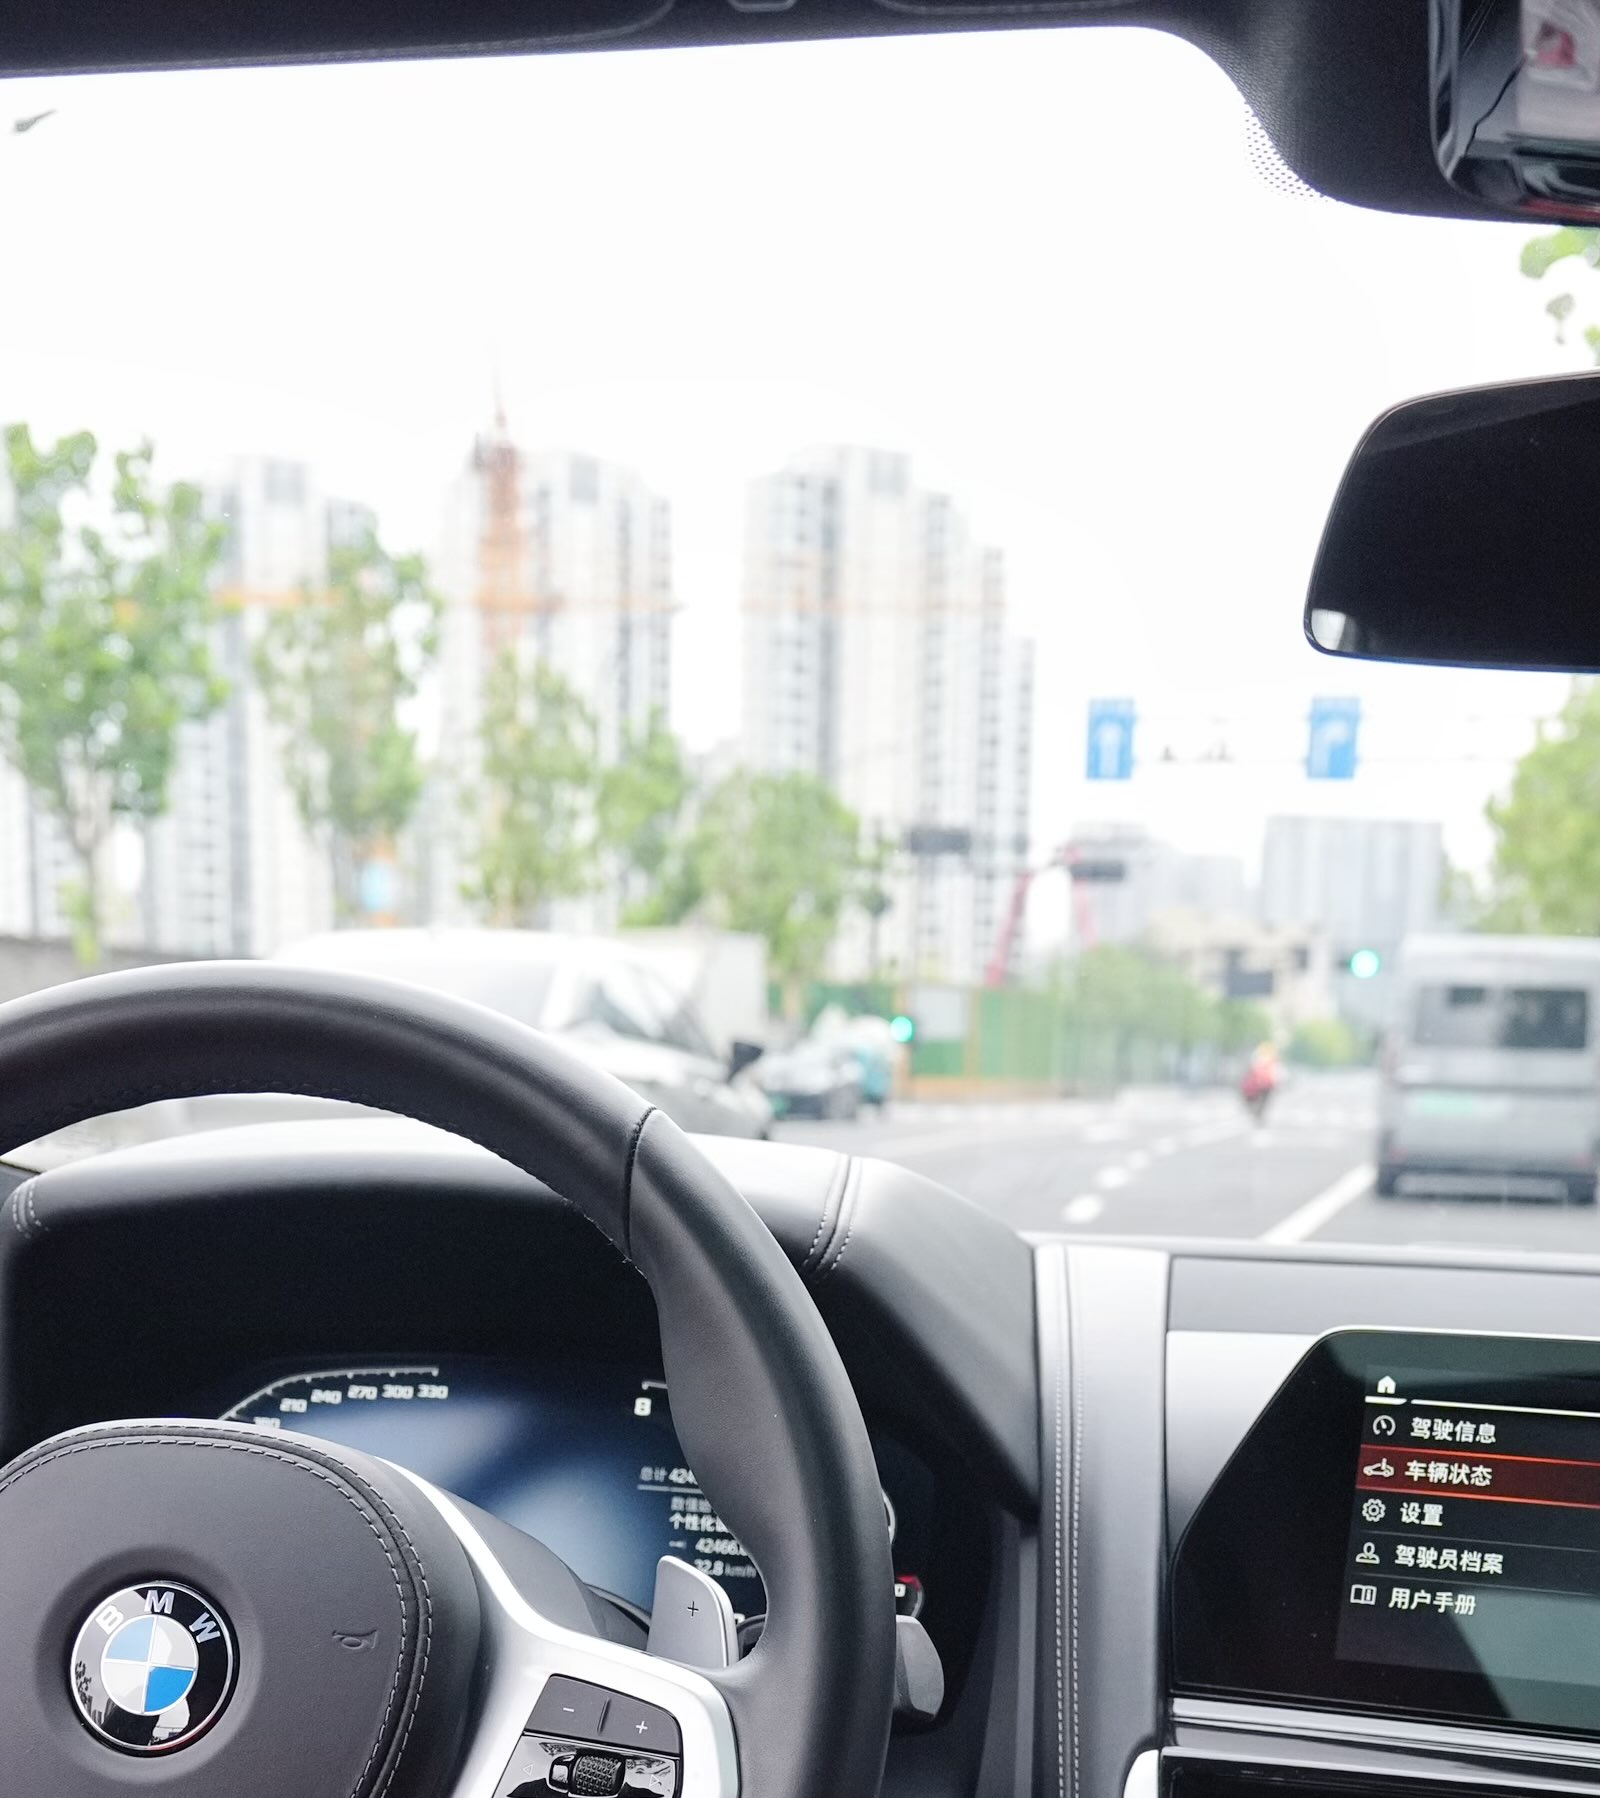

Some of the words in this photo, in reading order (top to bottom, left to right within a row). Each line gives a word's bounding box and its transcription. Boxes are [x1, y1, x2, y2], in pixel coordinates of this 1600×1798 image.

[1410, 1416, 1496, 1444] 驾驶信息
[1405, 1460, 1493, 1487] 车辆状态
[1400, 1502, 1444, 1527] 设置
[1395, 1544, 1504, 1574] 驾驶员档案
[1388, 1587, 1477, 1616] 用户手册
